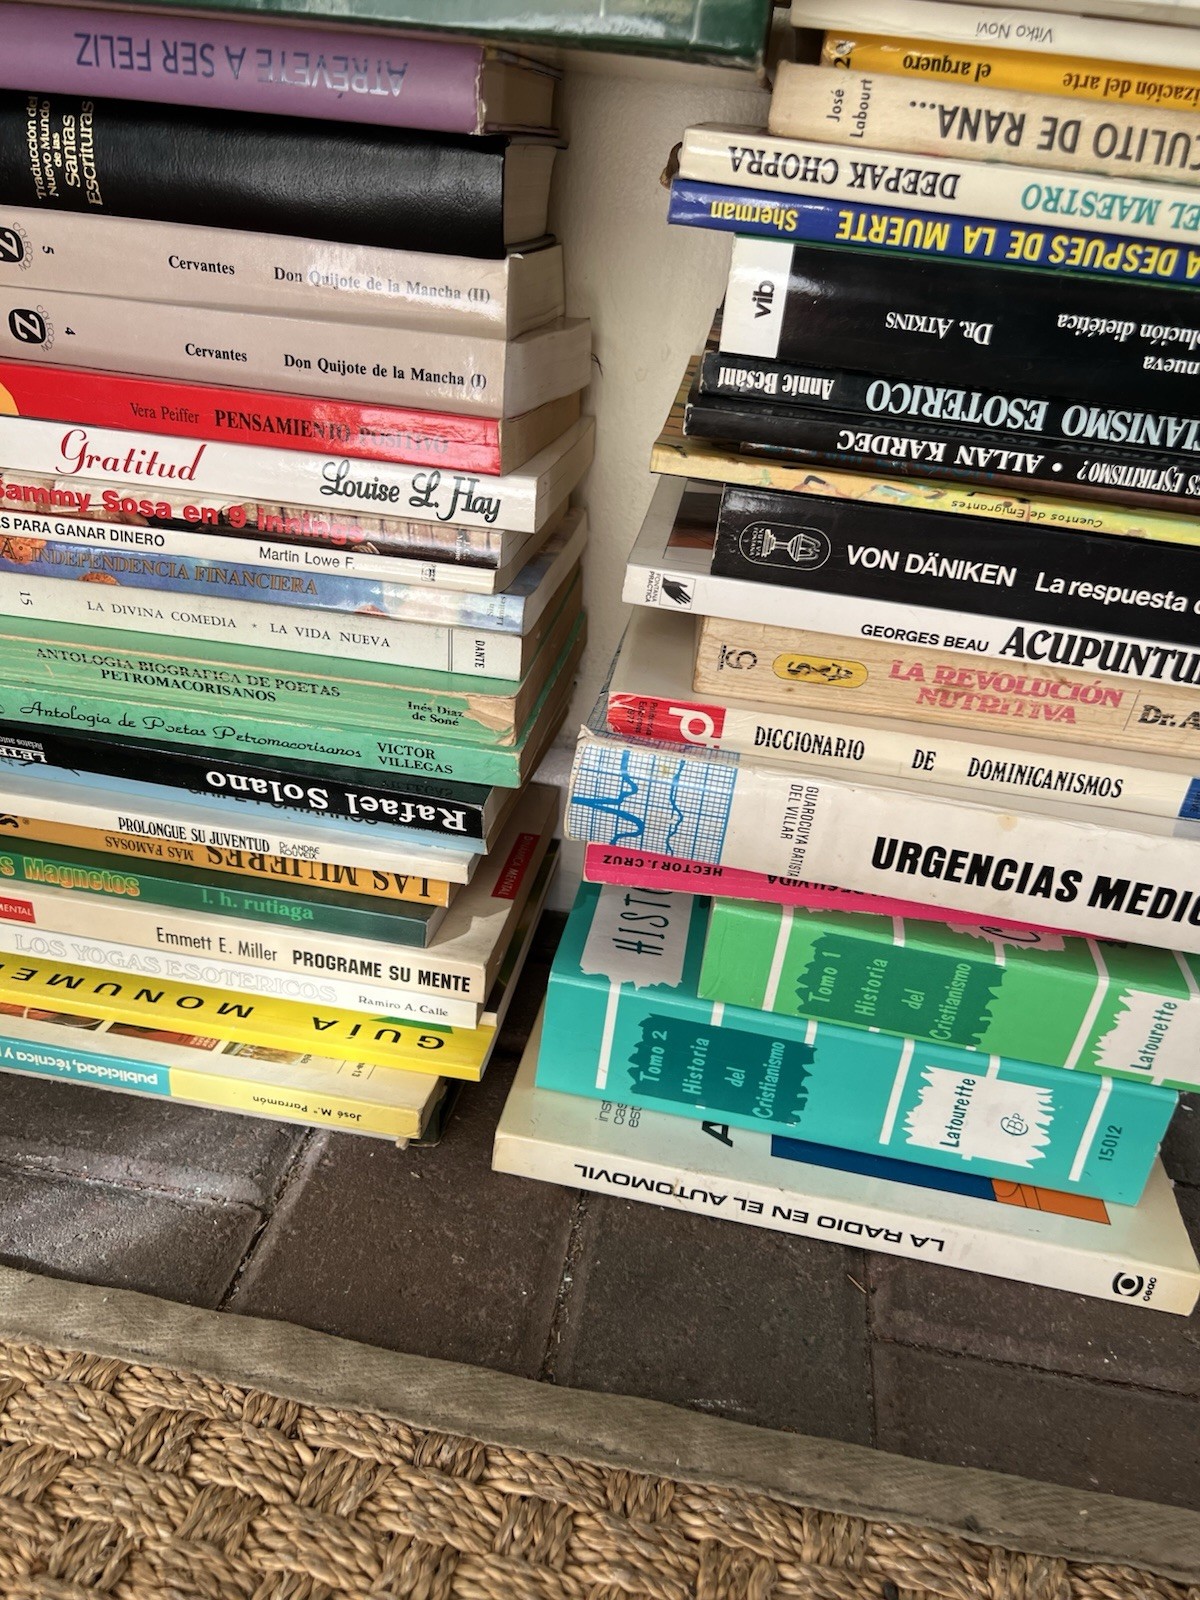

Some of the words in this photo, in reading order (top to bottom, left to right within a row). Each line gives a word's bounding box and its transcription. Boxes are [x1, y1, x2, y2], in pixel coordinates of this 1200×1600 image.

[74, 33, 151, 71] FELIZ
[162, 40, 215, 78] SER
[224, 45, 247, 80] A
[973, 63, 991, 82] el
[1063, 73, 1091, 91] arte
[1103, 75, 1130, 95] del
[826, 89, 845, 123] José
[849, 78, 872, 138] Labourt
[39, 101, 51, 150] Mundo
[1036, 116, 1082, 154] DE
[52, 132, 60, 150] las
[61, 114, 81, 188] Santas
[79, 101, 103, 205] Escrituras
[43, 152, 59, 197] Nuevo
[53, 152, 62, 168] de
[728, 145, 839, 184] CHOPRA
[847, 161, 960, 200] DEEPAK
[710, 201, 798, 232] Sherman
[1020, 183, 1162, 225] MAESTRO
[835, 210, 951, 251] MUERTE
[962, 225, 997, 256] LA
[1005, 230, 1045, 261] DE
[42, 245, 55, 255] 5
[168, 255, 235, 275] Cervantes
[1048, 234, 1179, 277] DESPUES
[273, 267, 303, 283] Don
[308, 270, 360, 290] Quijote
[366, 277, 382, 291] de
[387, 279, 400, 293] la
[406, 281, 461, 299] Mancha
[468, 287, 490, 303] (II)
[753, 280, 775, 319] vib
[65, 326, 76, 336] 4
[1057, 313, 1135, 342] dietética
[185, 343, 248, 362] Cervantes
[1143, 355, 1200, 375] nueva
[284, 354, 311, 370] Don
[317, 357, 367, 377] Quijote
[372, 364, 388, 378] de
[392, 366, 404, 379] la
[410, 368, 464, 386] Mancha
[470, 374, 487, 390] (I)
[718, 366, 778, 394] Besant
[782, 377, 835, 400] Annie
[129, 402, 156, 420] Vera
[161, 406, 199, 424] Peiffer
[866, 380, 1050, 432] ESOTERICO
[214, 409, 350, 442] PENSAMIENTO
[55, 429, 207, 482] Gratitud
[837, 430, 948, 462] KARDEC
[954, 444, 1044, 473] ALLAN
[319, 459, 400, 503] Louise
[436, 476, 501, 523] Hay
[102, 490, 173, 520] Sosa
[183, 504, 219, 525] en
[228, 506, 246, 529] 9
[257, 505, 365, 546] innings
[951, 500, 1024, 519] Emigrantes
[1030, 510, 1046, 521] de
[1050, 513, 1103, 528] Cuentos
[14, 518, 51, 534] PARA
[55, 523, 105, 541] GANAR
[109, 529, 165, 547] DINERO
[754, 527, 764, 557] NUEVA
[30, 547, 189, 581] INDEPENDENCIA
[194, 565, 318, 595] FINANCIERA
[259, 547, 299, 563] Martin
[304, 552, 340, 568] Lowe
[652, 573, 661, 602] FONTANA
[847, 545, 900, 571] VON
[904, 551, 1017, 588] DÄNIKEN
[1034, 572, 1064, 595] La
[1069, 579, 1188, 613] respuesta
[19, 591, 33, 606] 15
[87, 601, 104, 613] LA
[112, 604, 164, 619] DIVINA
[171, 611, 236, 629] COMEDIA
[270, 623, 287, 635] LA
[294, 626, 331, 641] VIDA
[339, 632, 390, 648] NUEVA
[860, 624, 940, 645] GEORGES
[943, 636, 990, 652] BEAU
[474, 640, 486, 668] DANTE
[138, 661, 241, 684] BIOGRAFICA
[246, 674, 271, 689] DE
[275, 678, 340, 698] POETAS
[888, 659, 926, 682] LA
[101, 669, 276, 703] PETROMACORISANOS
[407, 700, 433, 714] Inés
[411, 711, 427, 723] de
[430, 713, 460, 727] Soné
[915, 687, 1077, 725] NUTRITIVA
[118, 712, 136, 728] de
[142, 716, 207, 737] Poetas
[377, 742, 435, 760] VICTOR
[377, 756, 453, 775] VILLEGAS
[754, 725, 866, 761] DICCIONARIO
[911, 749, 937, 771] DE
[966, 756, 1124, 799] DOMINICANISMOS
[206, 771, 328, 810] Solano
[791, 784, 804, 803] DEL
[345, 792, 467, 832] Rafael
[780, 805, 799, 840] VILLAR
[796, 786, 819, 846] GUAROCUYA
[105, 836, 163, 856] FAMOSAS
[118, 816, 187, 841] PROLONGUE
[191, 829, 206, 844] SU
[209, 831, 270, 853] JUVENTUD
[603, 854, 645, 868] CRUZ
[662, 861, 723, 877] HECTOR
[871, 836, 1083, 902] URGENCIAS
[23, 856, 140, 897] Magnetos
[243, 898, 314, 921] rutiaga
[14, 933, 67, 958] LOS
[71, 943, 162, 974] YOGAS
[165, 959, 338, 1003] ESOTERICOS
[156, 927, 212, 950] Emmett
[219, 938, 232, 955] E.
[238, 940, 278, 961] Miller
[292, 950, 382, 978] PROGRAME
[389, 966, 411, 982] SU
[418, 970, 471, 993] MENTE
[822, 950, 841, 958] 1
[808, 965, 838, 1003] Tomo
[855, 958, 888, 1016] Historia
[358, 995, 401, 1010] Ramiro
[403, 1002, 417, 1013] A.
[419, 1004, 449, 1017] Calle
[901, 988, 925, 1011] del
[929, 962, 971, 1041] Cristianismo
[652, 1030, 668, 1041] 2
[1130, 1000, 1178, 1071] Latourette
[4, 1045, 15, 1059] y
[17, 1051, 71, 1073] técnica
[640, 1046, 665, 1083] Tomo
[682, 1037, 710, 1095] Historia
[724, 1067, 746, 1087] del
[752, 1041, 786, 1118] Cristianismo
[252, 1095, 308, 1113] Parramón
[337, 1110, 362, 1122] José
[940, 1077, 976, 1148] Latourette
[1098, 1125, 1123, 1162] 15012
[574, 1163, 728, 1206] AUTOMOVIL
[733, 1197, 763, 1215] EL
[772, 1206, 808, 1224] EN
[817, 1215, 903, 1244] RADIO
[910, 1234, 945, 1252] LA
[1142, 1276, 1157, 1303] ceac
